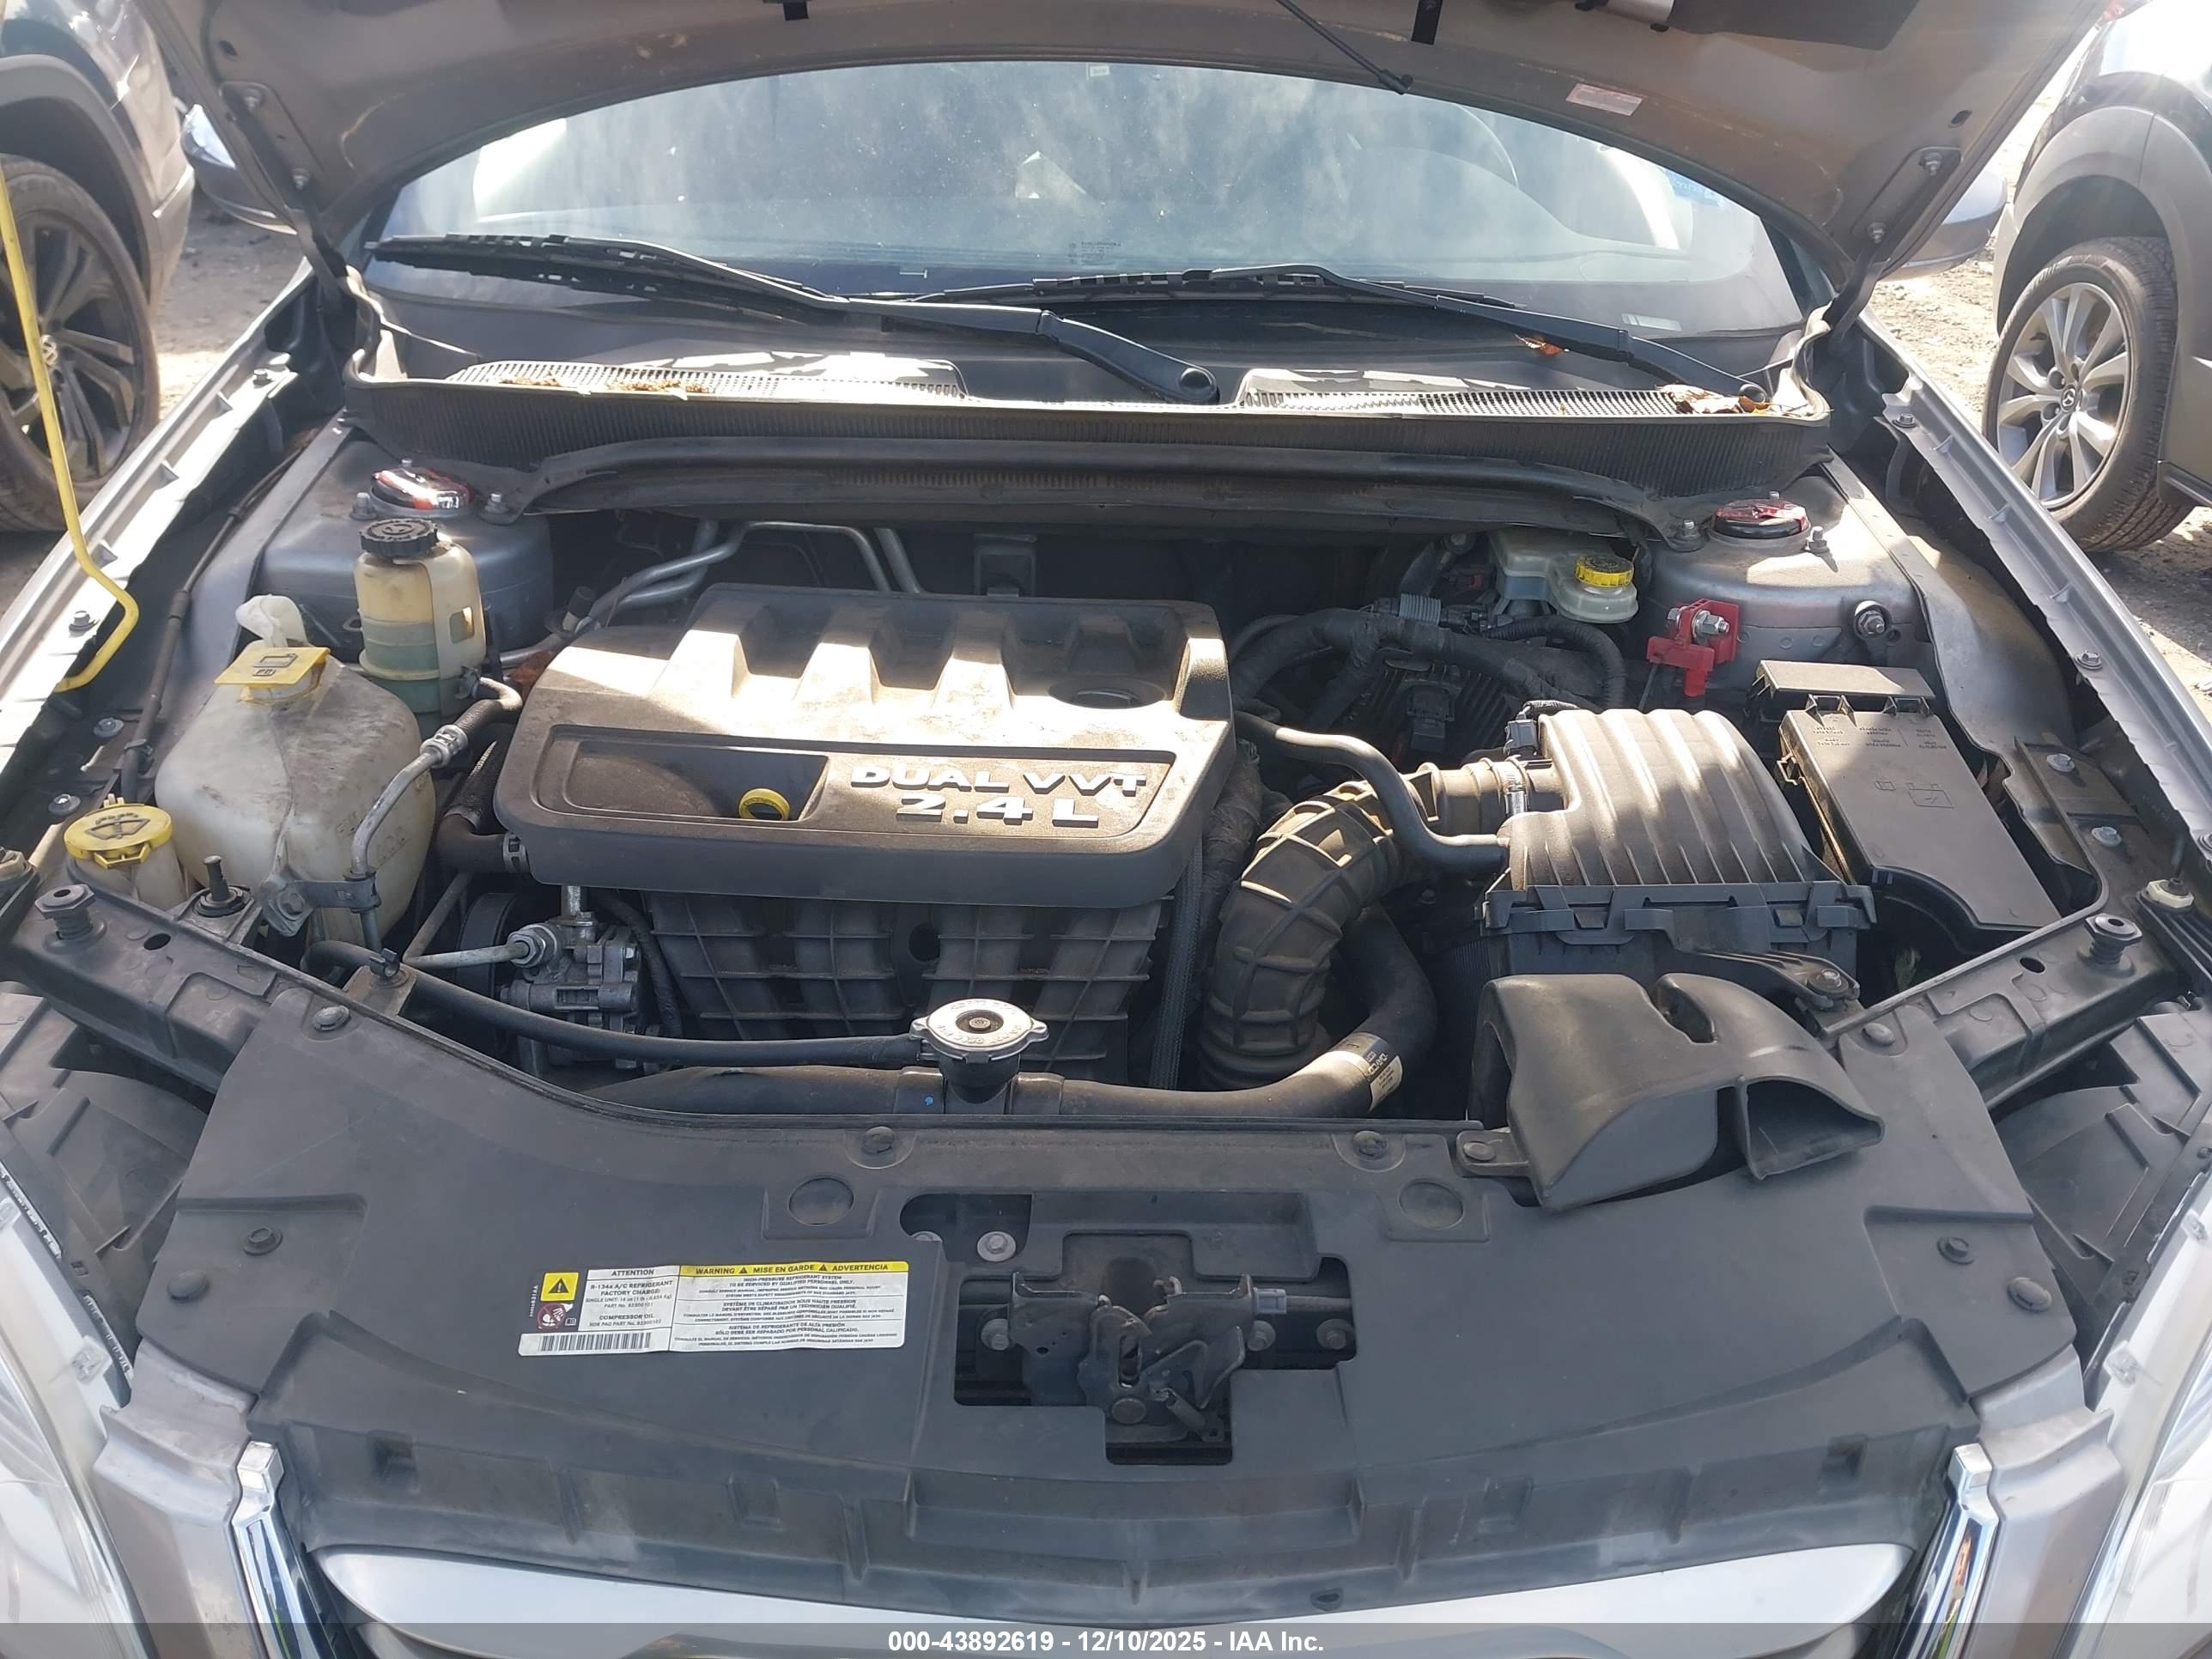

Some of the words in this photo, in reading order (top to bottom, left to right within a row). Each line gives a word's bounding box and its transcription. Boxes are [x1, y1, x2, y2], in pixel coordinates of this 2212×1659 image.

[851, 766, 1010, 793] DUAL
[1023, 772, 1147, 797] VVT
[787, 1264, 816, 1273] GARDE
[832, 1263, 889, 1272] ADVERTENCIA
[629, 1279, 674, 1289] REFRIGERANT
